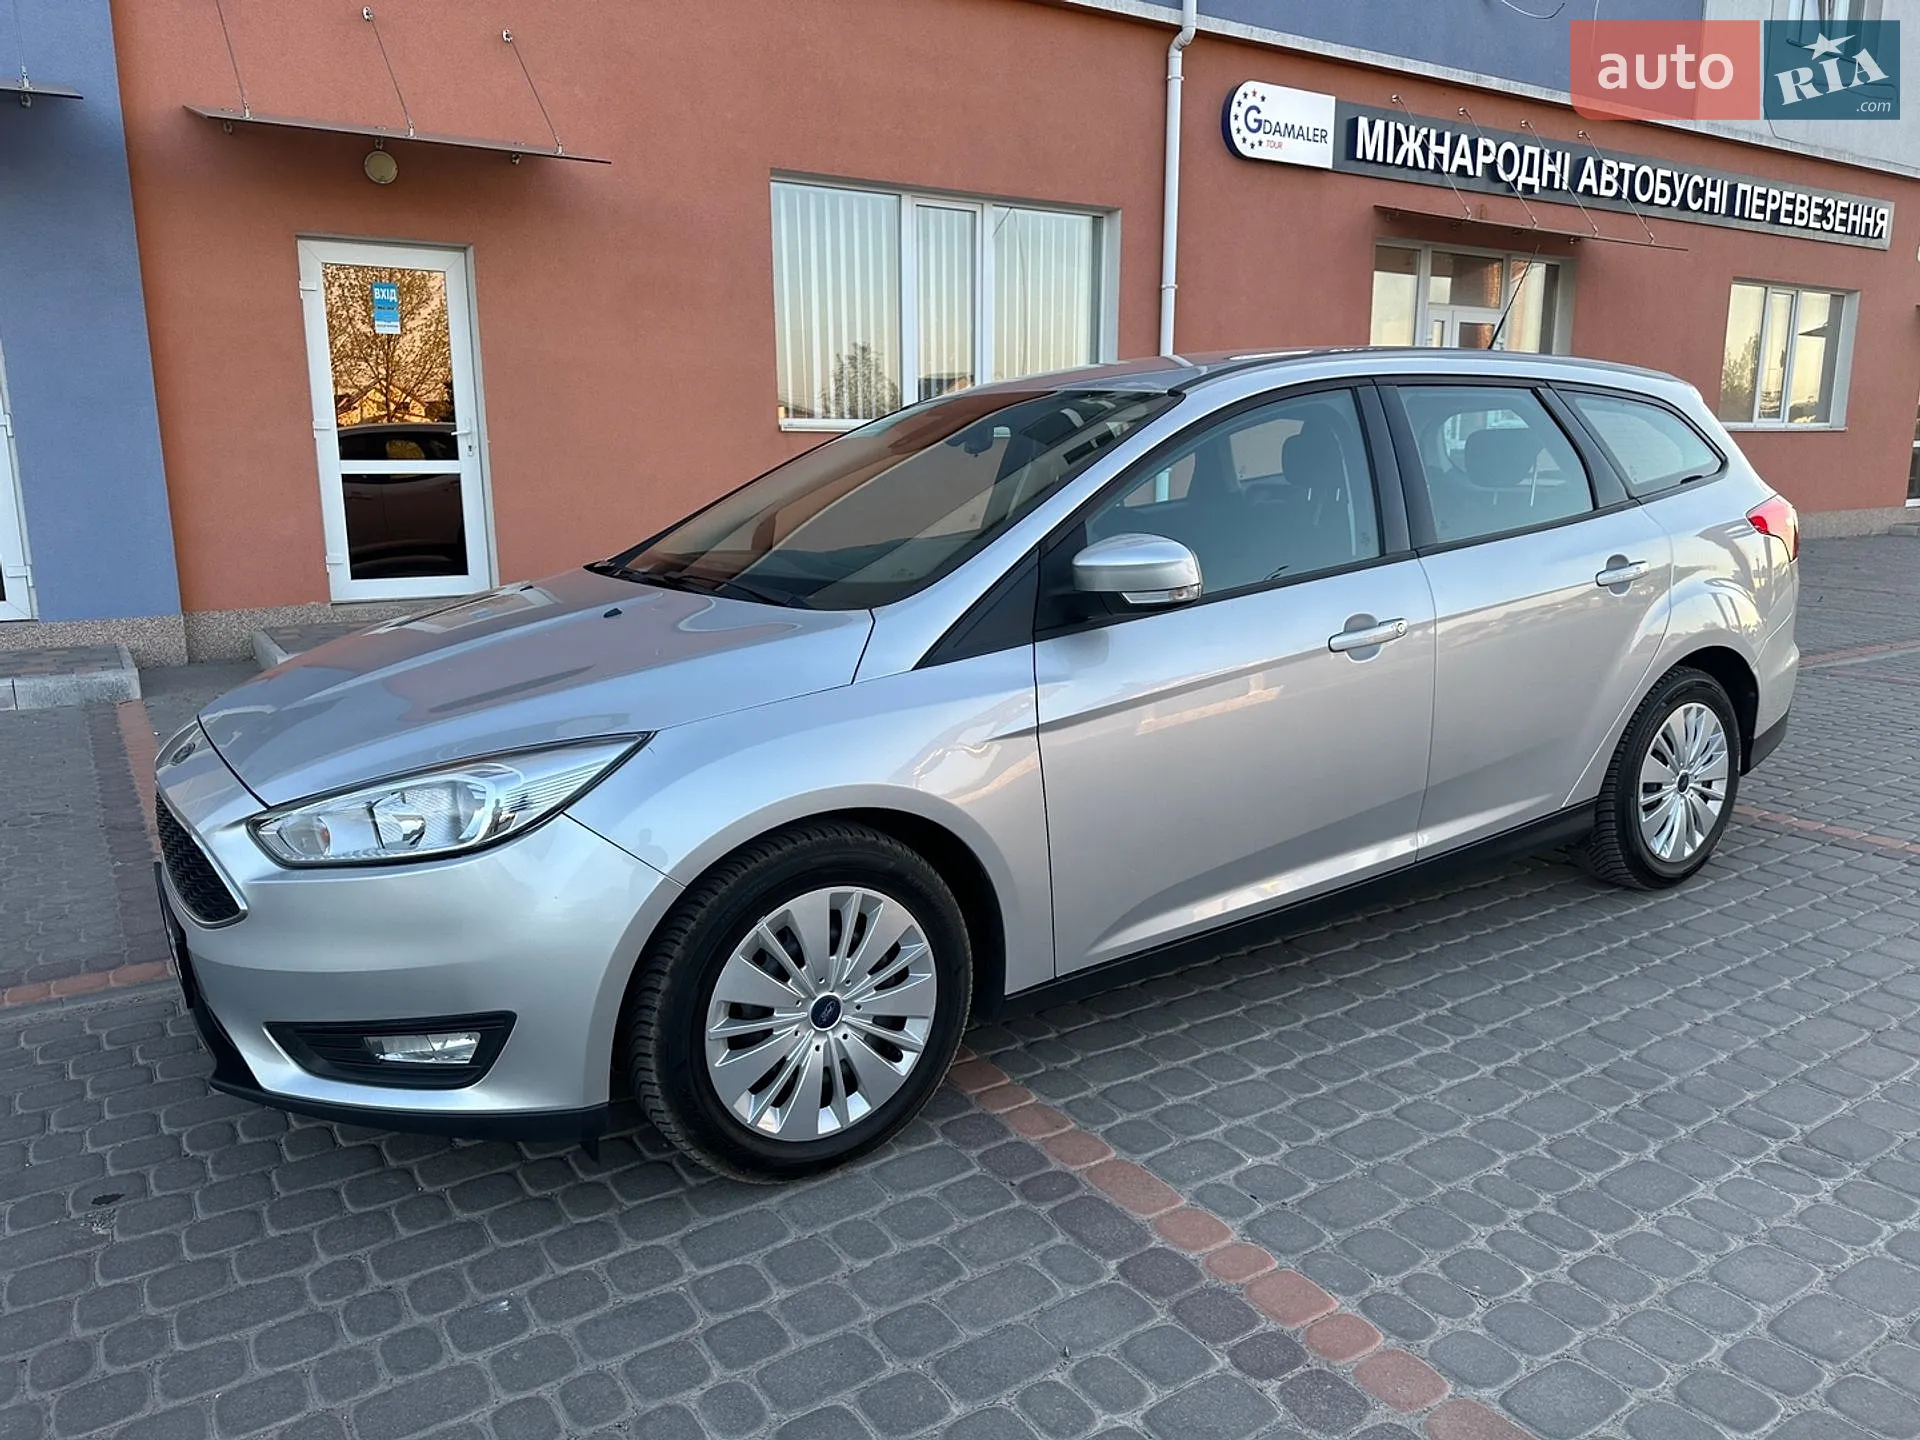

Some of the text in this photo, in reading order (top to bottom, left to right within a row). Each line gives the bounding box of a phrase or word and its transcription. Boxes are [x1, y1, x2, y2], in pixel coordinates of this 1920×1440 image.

[1244, 105, 1328, 144] GDAMALER
[1266, 140, 1283, 150] TOUR
[1355, 115, 1889, 239] МІЖНАРОДНІ АВТОБУСНІ ПЕРЕВЕЗЕННЯ
[374, 288, 397, 302] ВХІД
